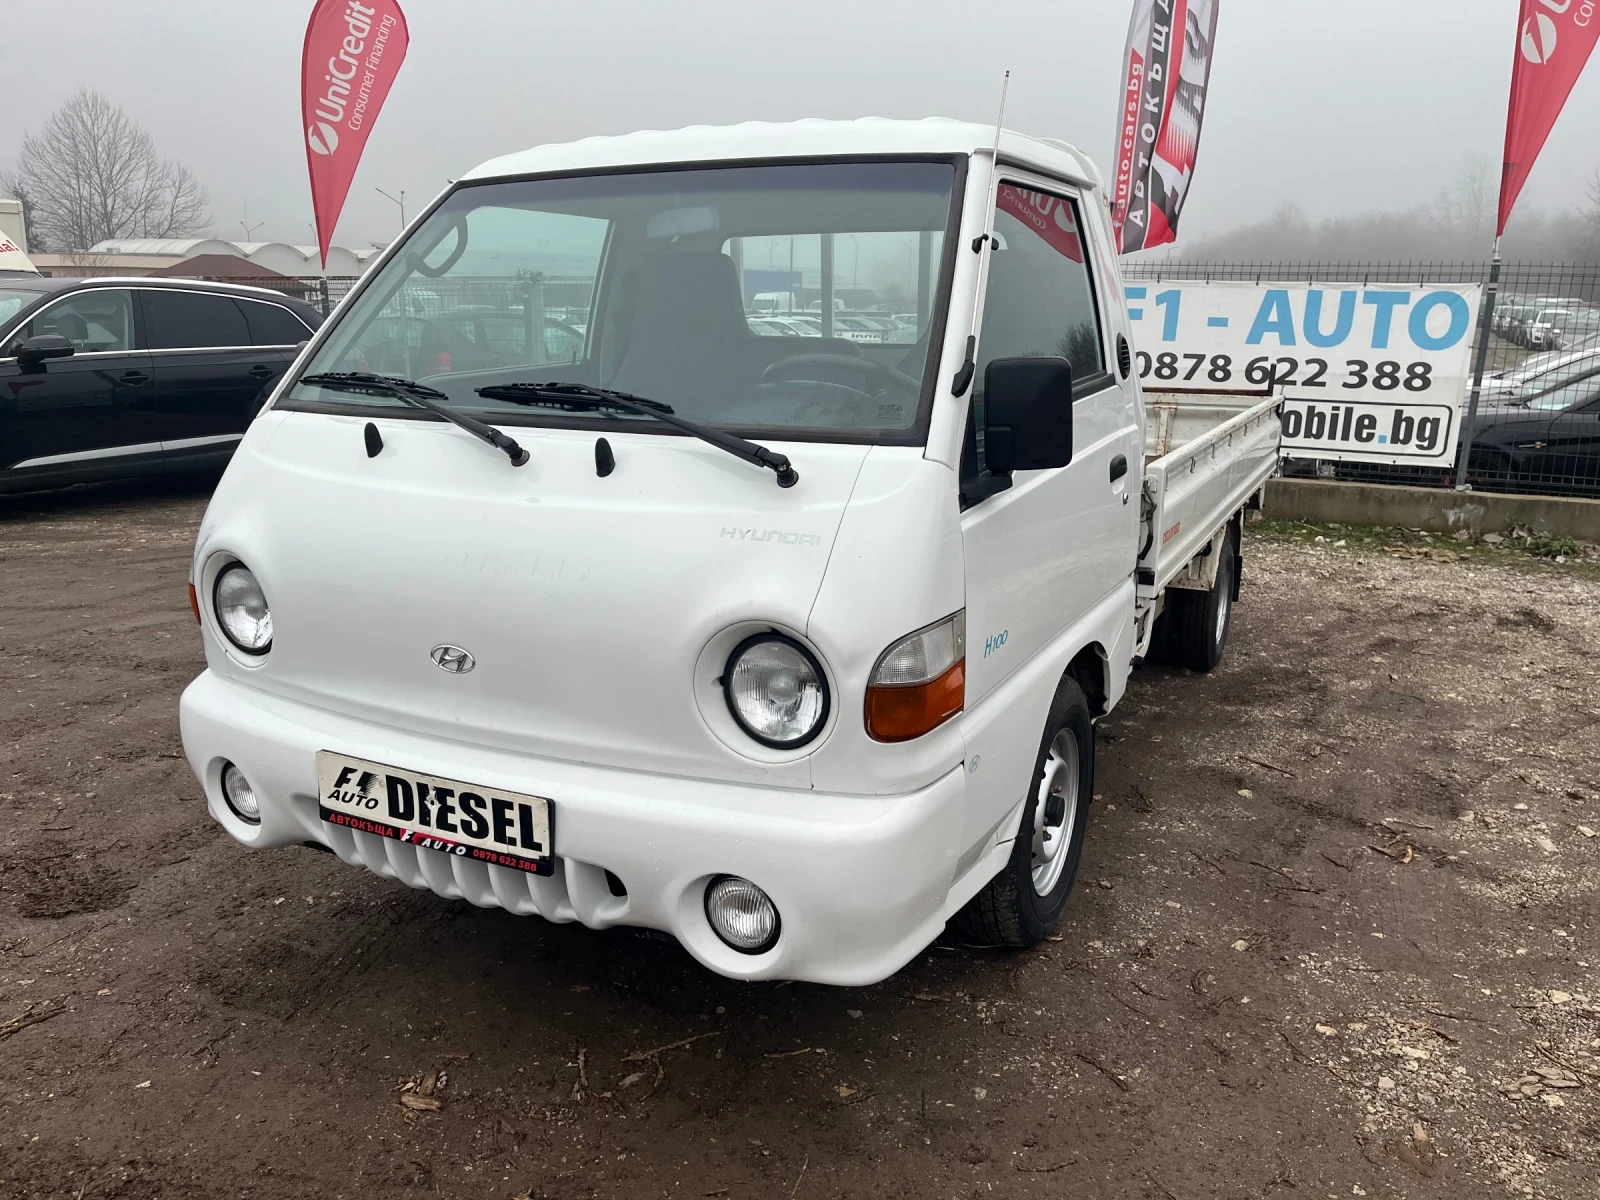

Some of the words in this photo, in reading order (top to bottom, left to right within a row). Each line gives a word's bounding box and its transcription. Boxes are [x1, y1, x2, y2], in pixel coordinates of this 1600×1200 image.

[315, 0, 375, 122] UniCredit
[348, 70, 375, 131] Consumer
[365, 14, 396, 70] Financing
[1112, 62, 1143, 228] f-auto.cars.bg
[1124, 287, 1182, 341] F1
[1245, 289, 1469, 351] AUTO
[1136, 351, 1232, 382] 0878
[1245, 356, 1328, 388] 622
[1342, 360, 1432, 391] 388
[1282, 405, 1440, 450] obile.bg
[720, 527, 821, 546] HYUNDAI
[983, 630, 1008, 659] H100
[327, 789, 379, 810] AUTO
[385, 774, 543, 853] DIESEL
[328, 813, 394, 837] АВТОКЪЩА
[421, 838, 467, 856] AUTO
[473, 849, 497, 862] 0878
[499, 855, 517, 867] 622
[518, 860, 537, 872] 388
